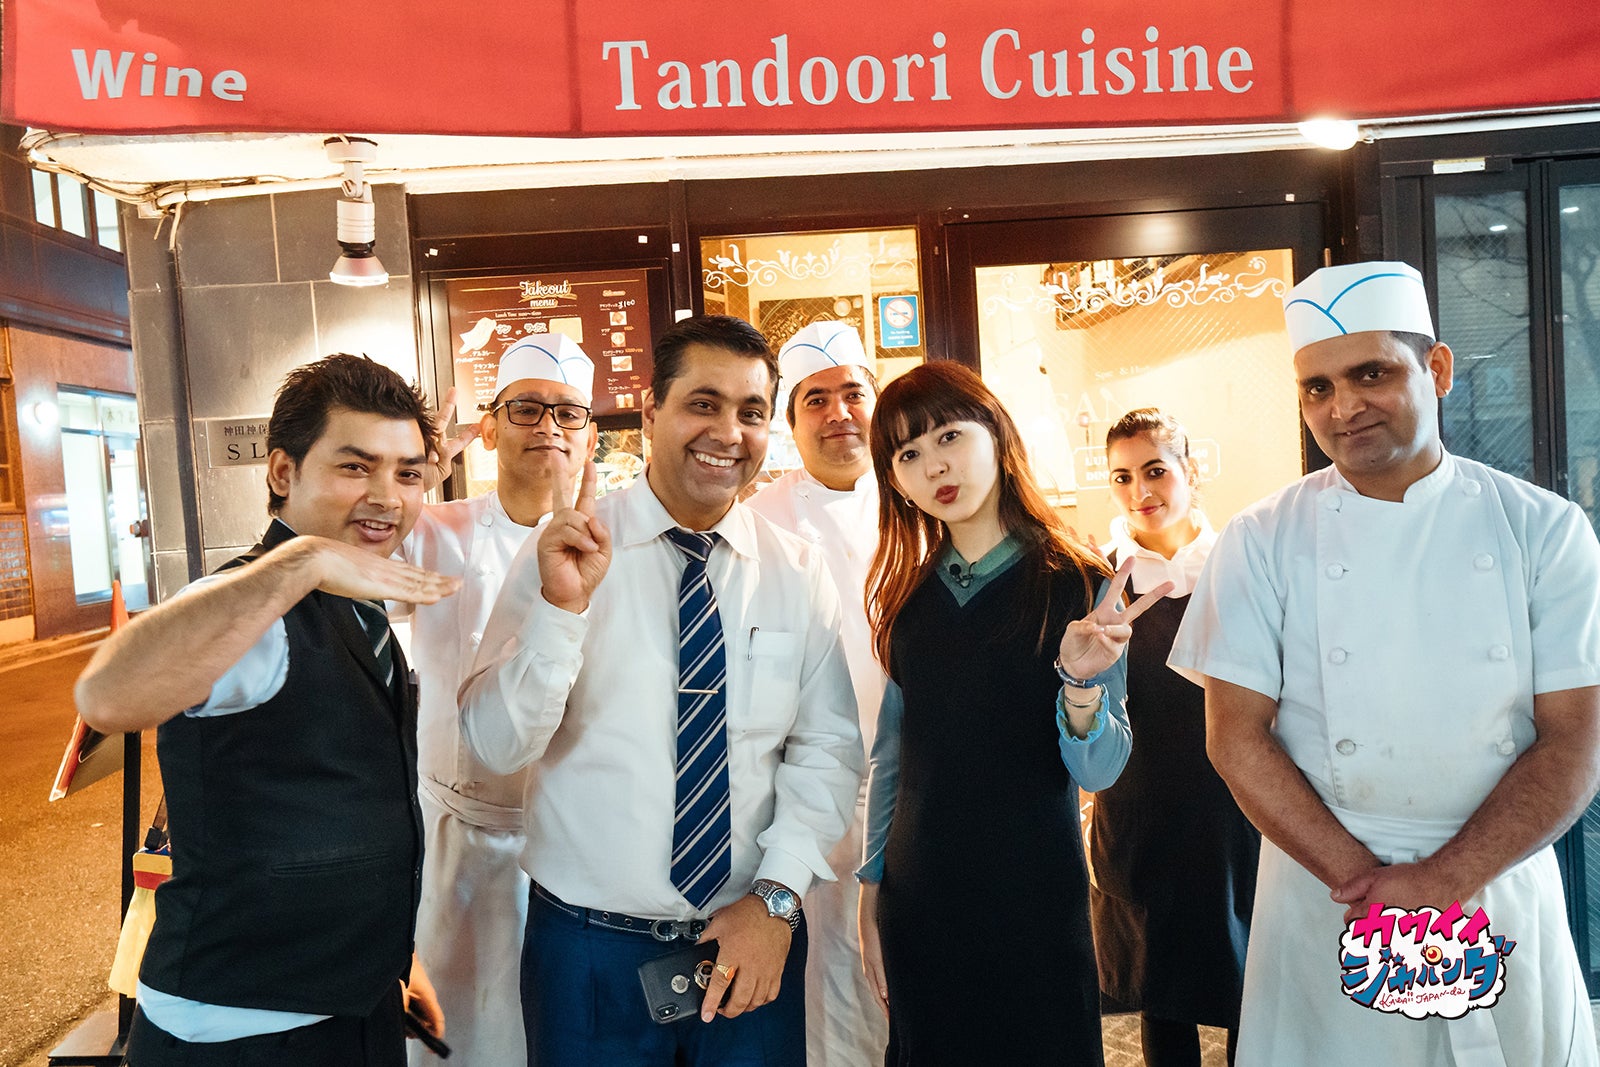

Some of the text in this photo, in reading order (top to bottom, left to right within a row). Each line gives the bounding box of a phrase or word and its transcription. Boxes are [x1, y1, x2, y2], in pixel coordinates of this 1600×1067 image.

[71, 48, 247, 102] Wine
[602, 26, 1255, 111] Tandoori Cuisine
[519, 280, 570, 297] Takeout
[530, 298, 557, 308] menu
[224, 424, 270, 437] 神田神保
